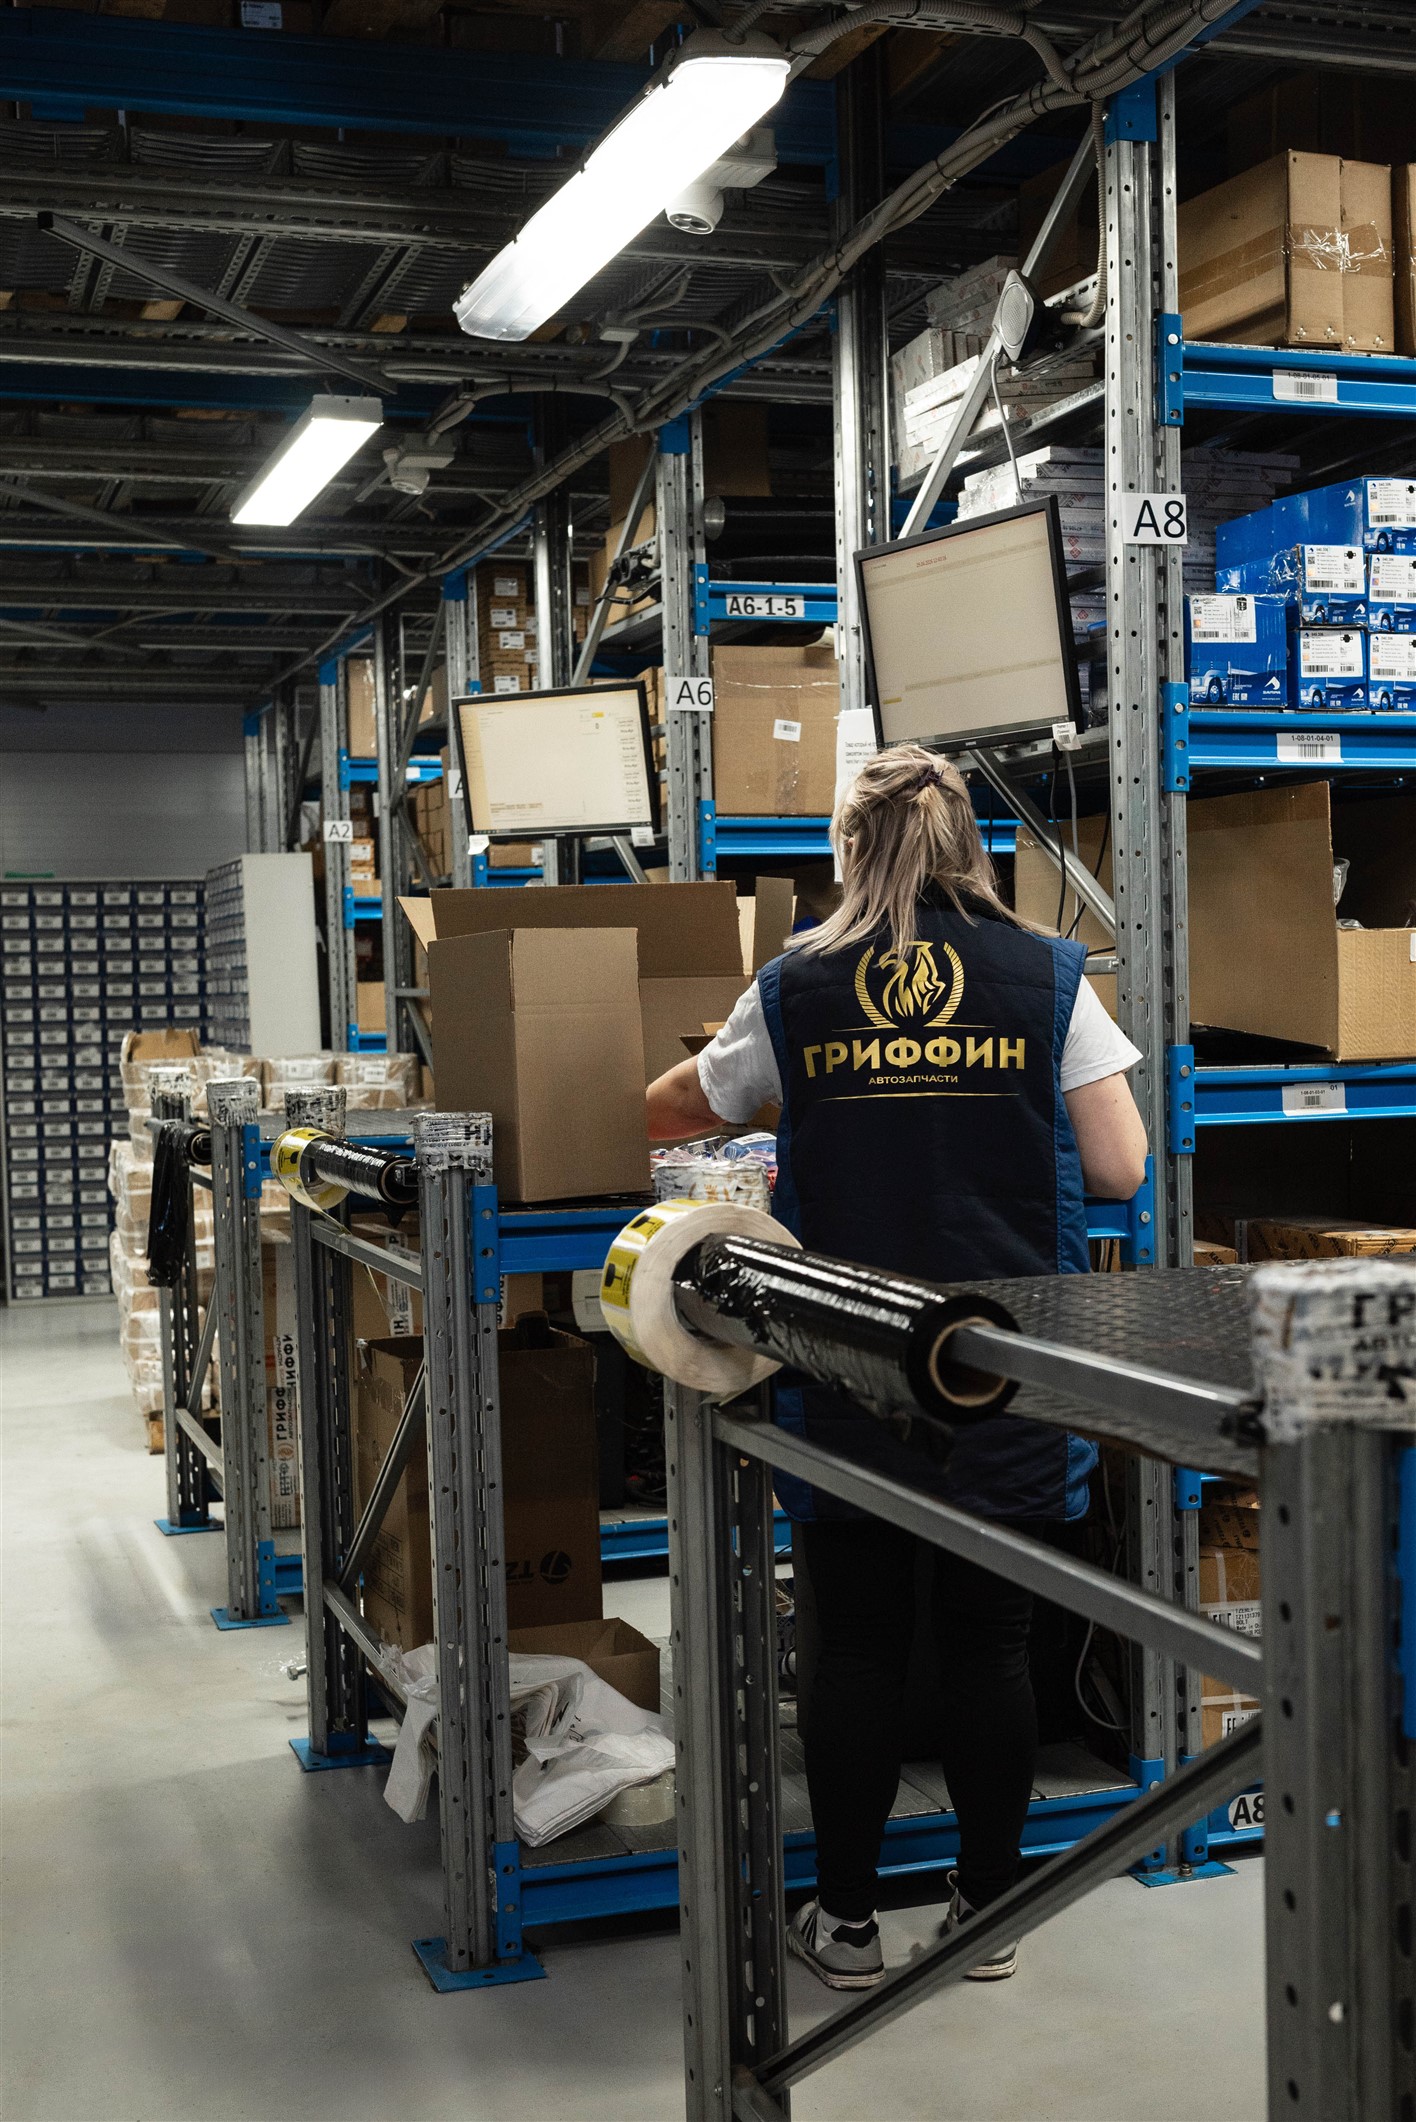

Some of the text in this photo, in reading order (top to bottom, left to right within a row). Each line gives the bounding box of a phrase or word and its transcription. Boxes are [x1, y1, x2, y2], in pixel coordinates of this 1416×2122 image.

[1133, 500, 1186, 538] A8
[728, 595, 797, 616] A6-1-5
[676, 680, 712, 706] A6
[1291, 734, 1334, 742] 1-08-01-04-01
[328, 823, 351, 839] A2
[803, 1035, 1026, 1078] ГРИФФИН
[867, 1073, 959, 1086] АВТОЗАПЧАСТИ
